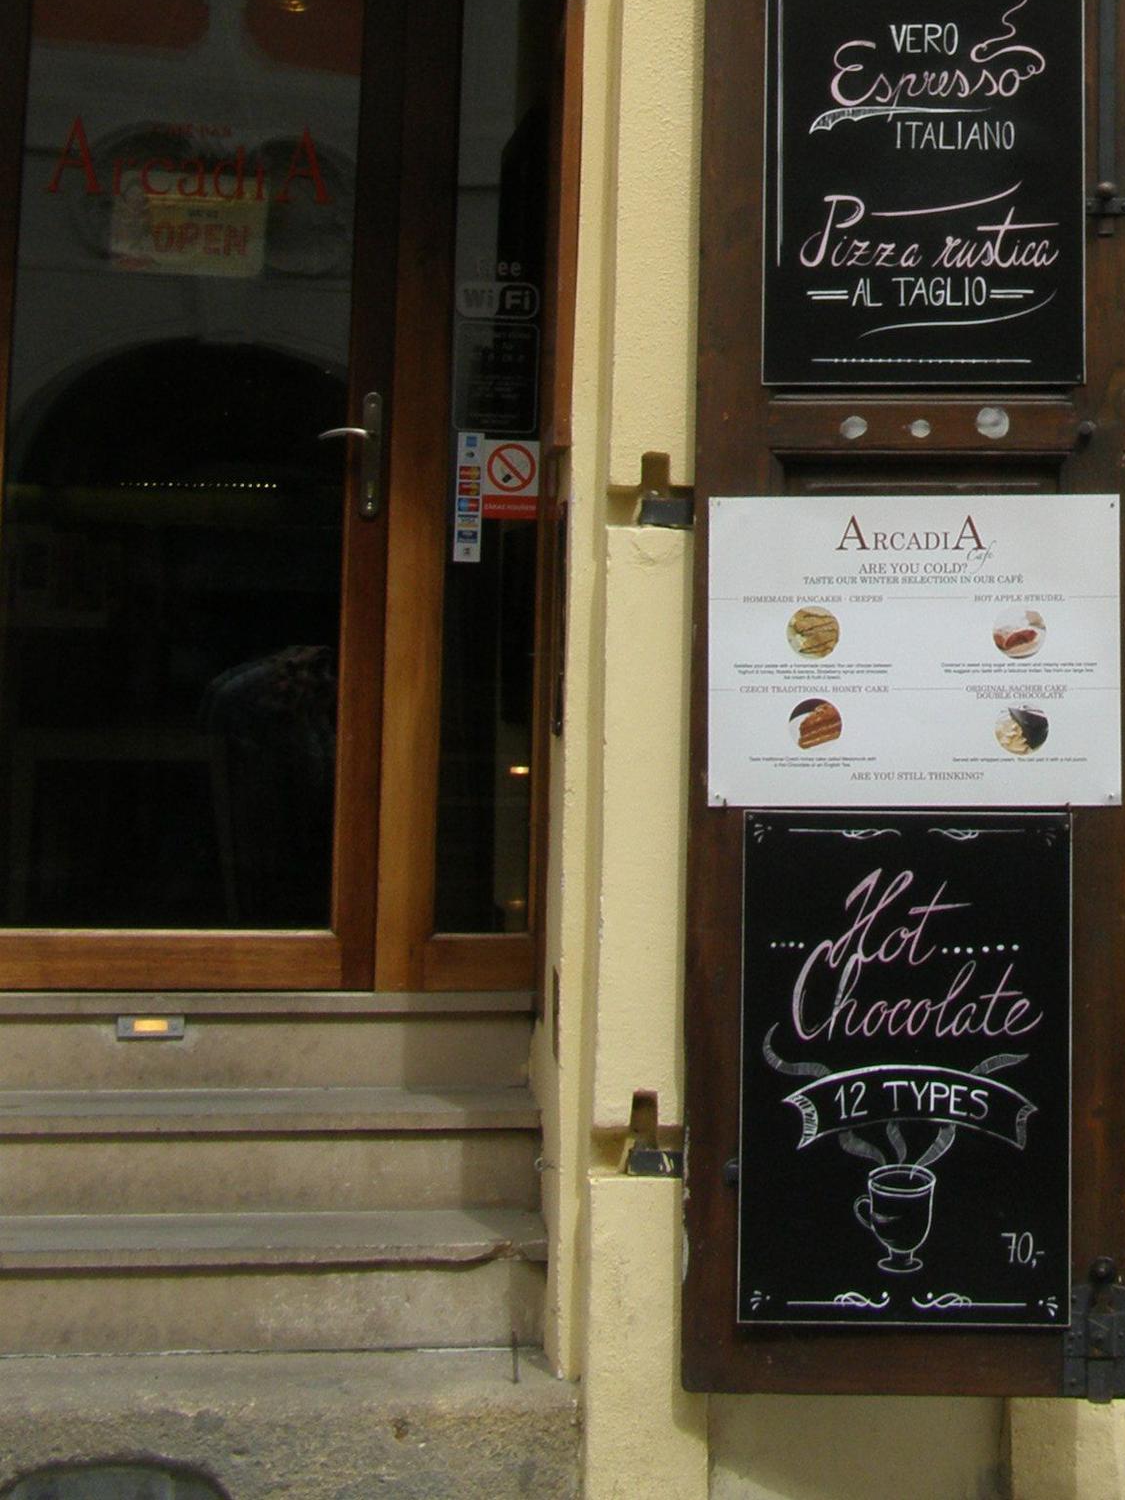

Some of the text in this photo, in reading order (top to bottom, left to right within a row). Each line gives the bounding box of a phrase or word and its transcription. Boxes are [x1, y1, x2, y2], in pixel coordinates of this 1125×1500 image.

[889, 22, 959, 55] VERO
[831, 40, 1028, 121] Espresso
[896, 121, 1015, 150] ITALIANO
[152, 220, 248, 256] OPEN
[800, 195, 1059, 268] Pizza rustica
[852, 276, 987, 306] AL TAGLIO
[803, 576, 834, 585] TASTE
[836, 576, 858, 585] OUR
[860, 576, 899, 585] WINTER
[901, 575, 957, 585] SELECTION
[960, 575, 971, 584] IN
[973, 575, 995, 584] OUR
[858, 562, 968, 574] ARE YOU COLD?
[739, 685, 769, 694] CZECH
[771, 685, 829, 693] TRADITIONAL
[864, 685, 889, 693] CAKE
[850, 772, 984, 781] ARE YOU STILL THINKING?
[825, 868, 972, 967] Hot
[793, 940, 1043, 1041] Chocolate
[834, 1081, 989, 1120] 12 TYPES
